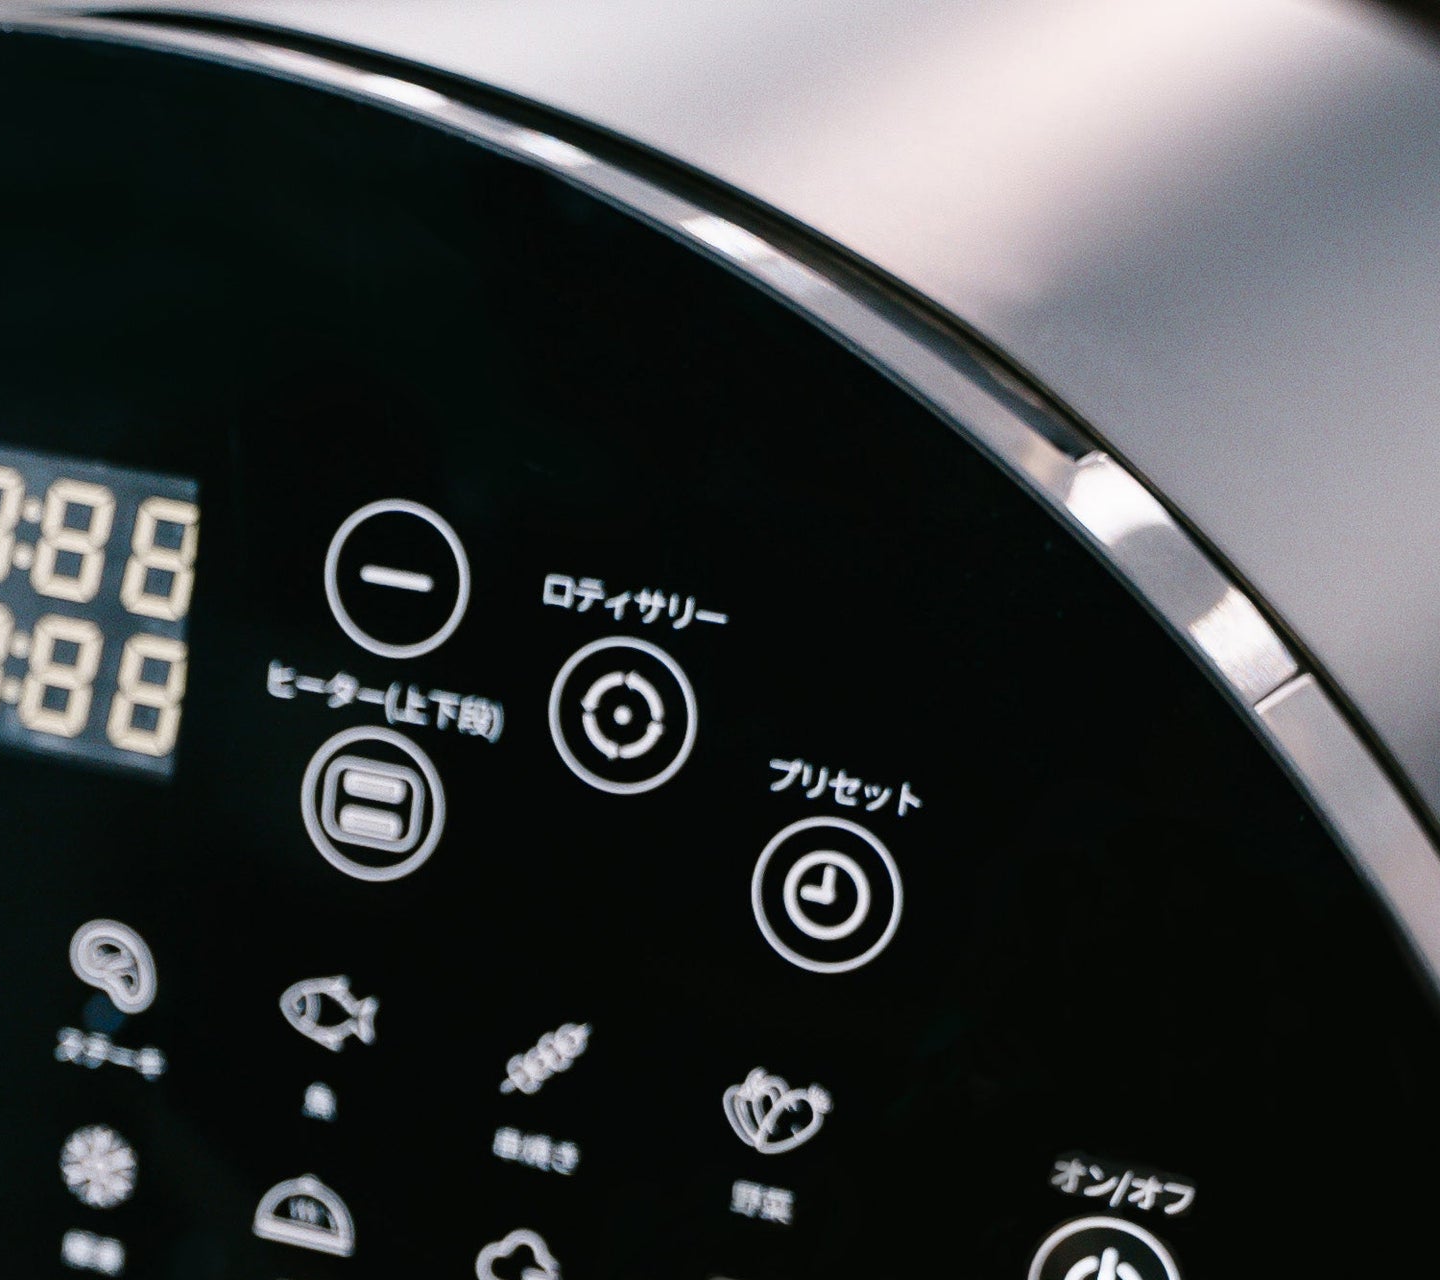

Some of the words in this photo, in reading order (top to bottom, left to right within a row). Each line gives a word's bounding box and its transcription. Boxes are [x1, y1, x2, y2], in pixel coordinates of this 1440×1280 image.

[542, 573, 728, 630] ロティサリー
[769, 758, 921, 817] プリセット
[1052, 1160, 1195, 1215] オン/オフ
